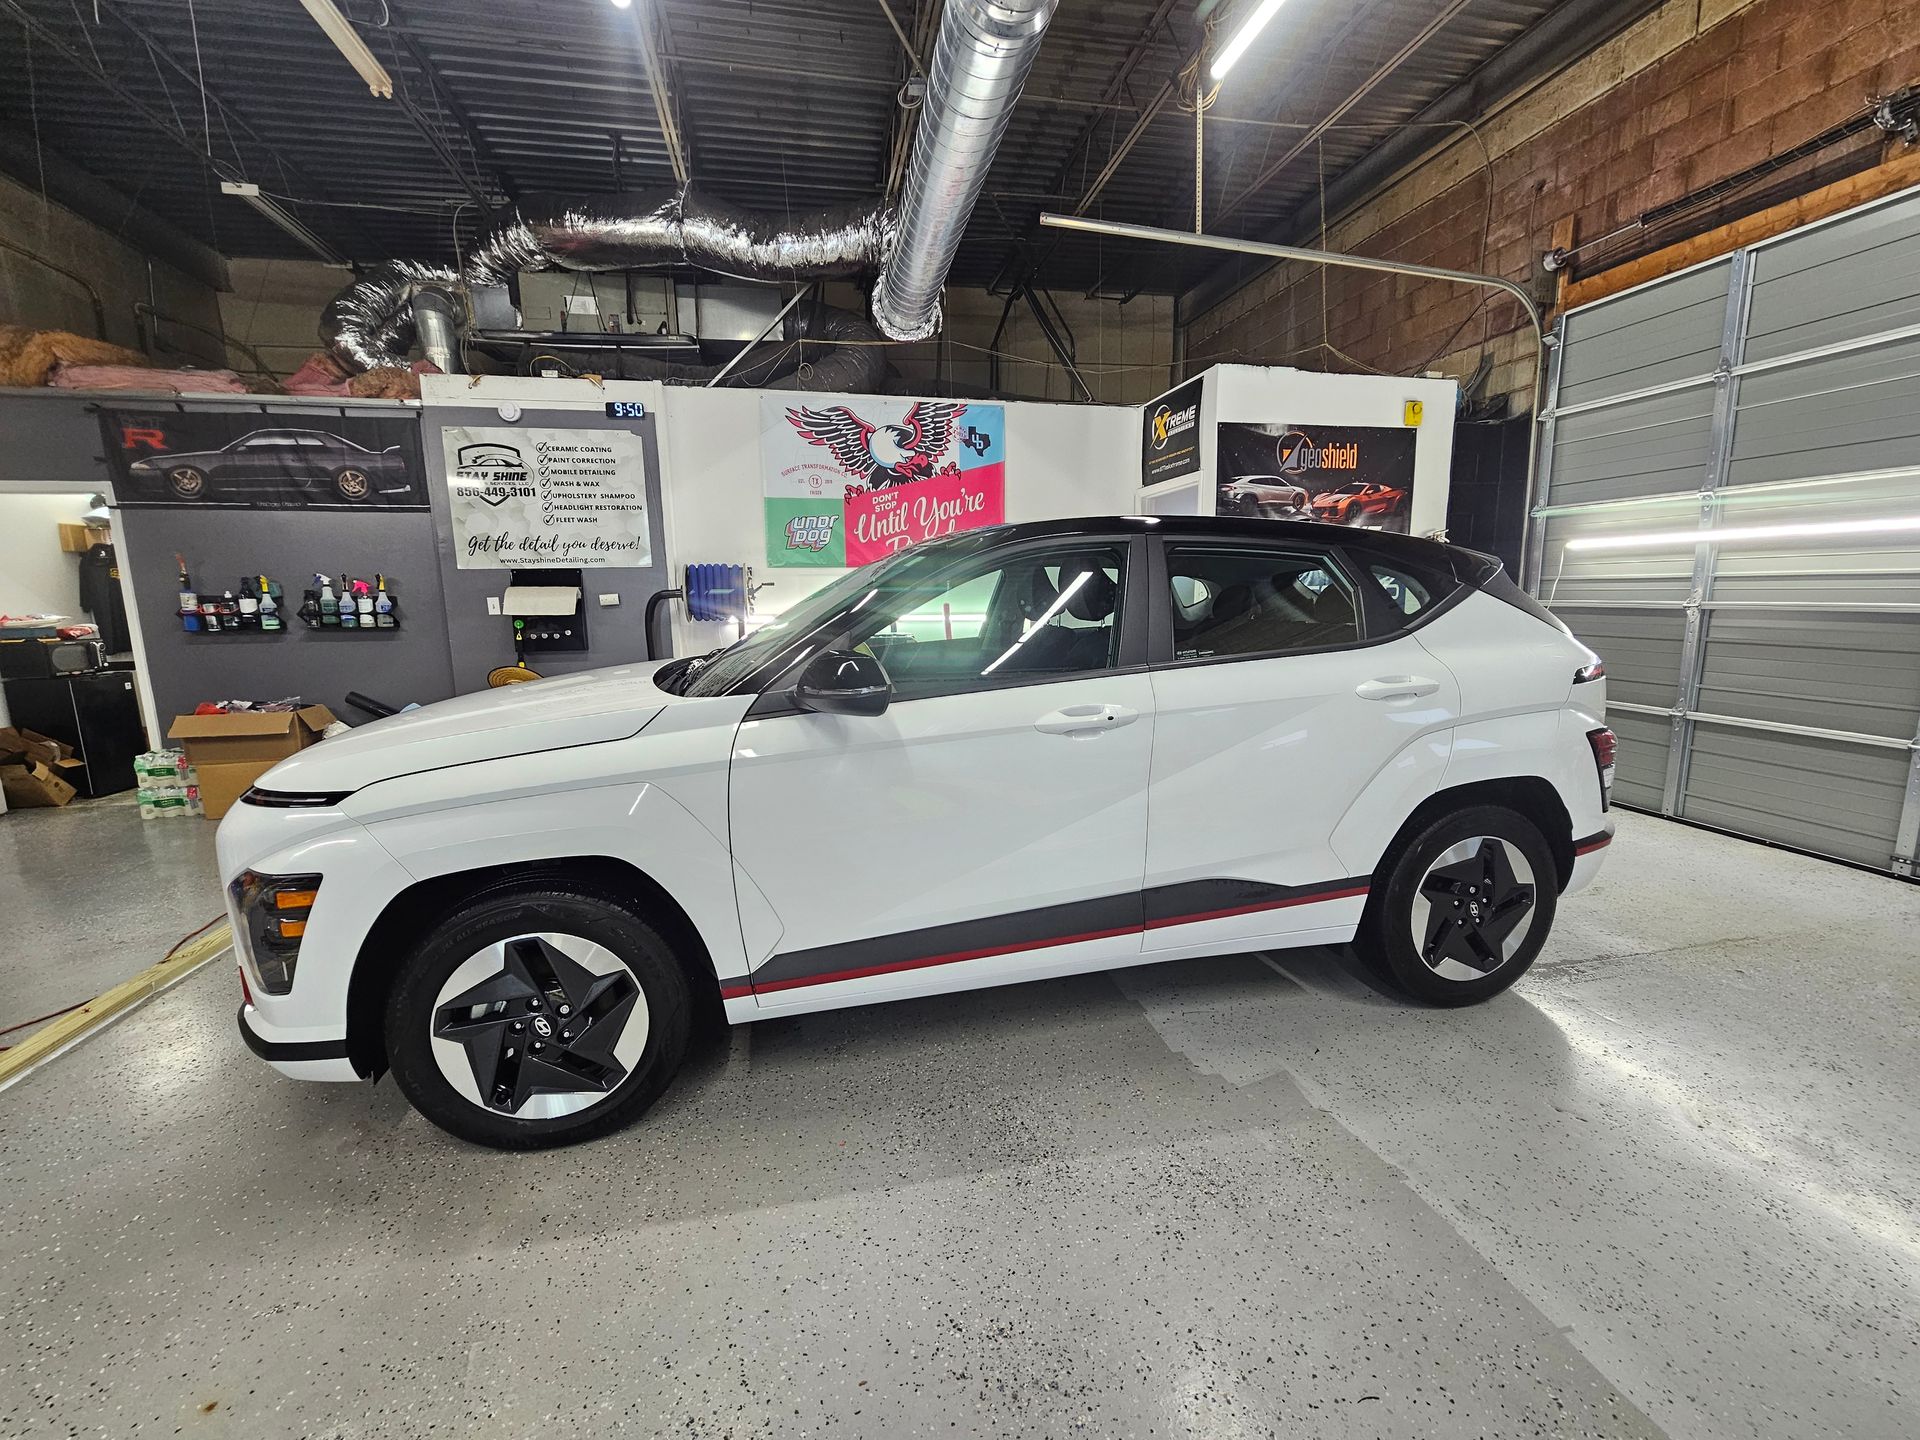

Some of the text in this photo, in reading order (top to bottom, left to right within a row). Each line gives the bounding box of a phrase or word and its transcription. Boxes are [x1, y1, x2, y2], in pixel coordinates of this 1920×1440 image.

[614, 402, 643, 417] 9:50
[1150, 404, 1197, 446] XTREME
[1301, 442, 1358, 472] geoshield
[493, 471, 528, 481] SHINE
[456, 486, 536, 497] 856-449-3101
[872, 491, 899, 504] DON'T
[875, 501, 897, 513] STOP
[853, 502, 910, 543] Until
[913, 488, 985, 540] You're
[468, 531, 641, 556] Get the detail you deserve!
